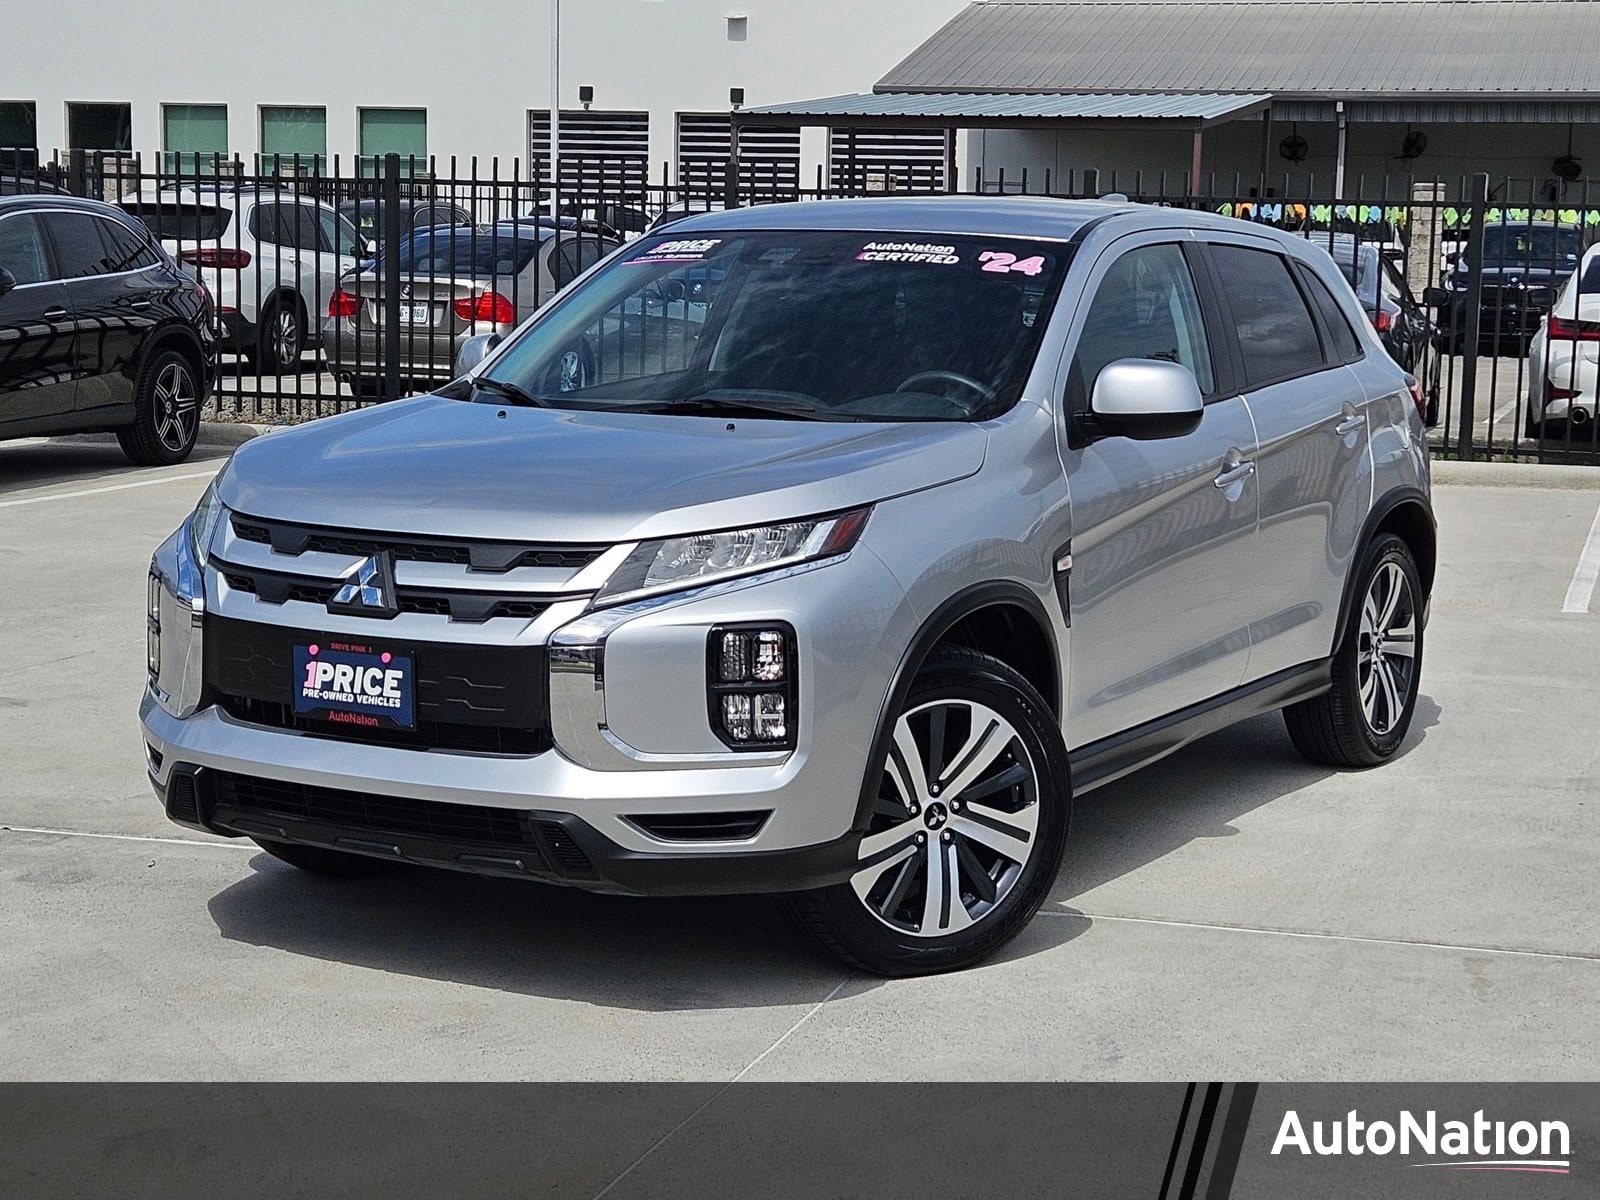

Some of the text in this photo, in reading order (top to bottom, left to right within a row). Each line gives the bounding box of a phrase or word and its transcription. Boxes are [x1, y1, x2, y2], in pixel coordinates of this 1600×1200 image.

[863, 242, 956, 254] AutoNation
[863, 252, 960, 265] CERTIFIED
[977, 251, 1046, 276] '24
[330, 642, 350, 652] DRIVE
[350, 645, 367, 653] PINK
[302, 687, 402, 708] PRE-OWNED VEHICLES
[328, 710, 379, 726] AutoNation
